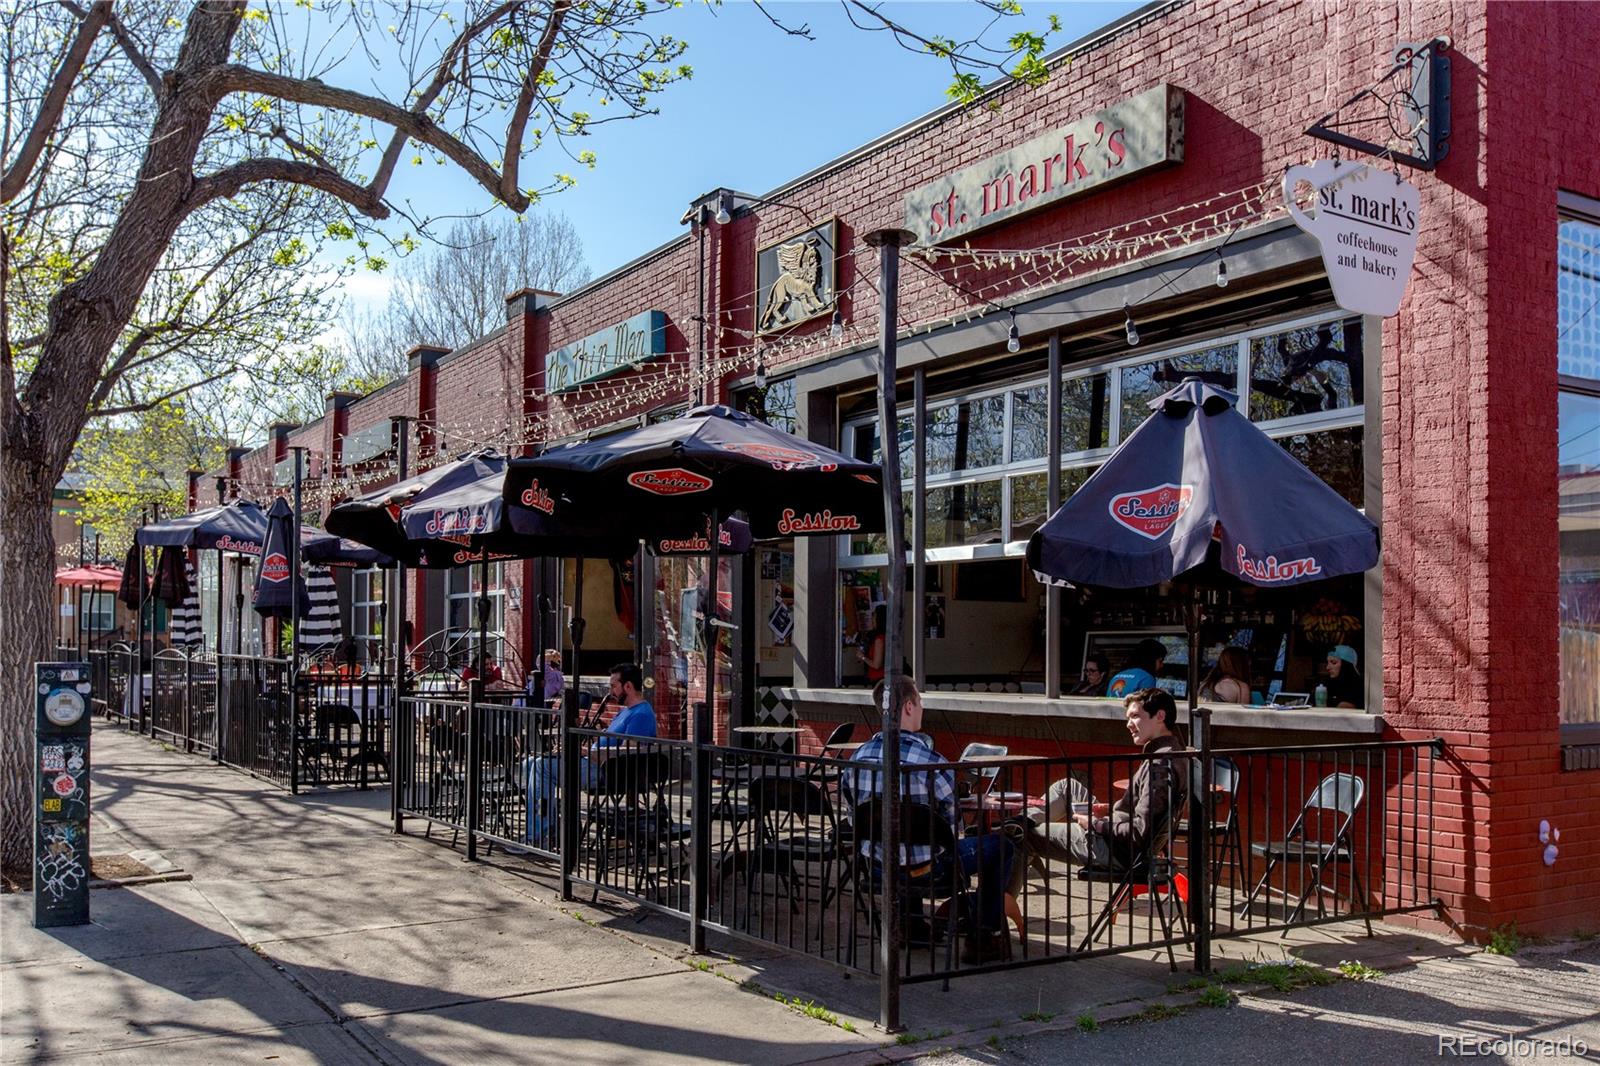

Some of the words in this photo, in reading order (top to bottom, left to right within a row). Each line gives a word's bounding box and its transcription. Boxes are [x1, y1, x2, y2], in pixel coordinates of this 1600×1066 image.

[930, 186, 968, 235] st.
[980, 120, 1127, 216] mark's
[1319, 186, 1343, 210] st.
[1351, 193, 1416, 231] mark's
[1336, 231, 1399, 258] coffeehouse
[1337, 254, 1357, 269] and
[1362, 256, 1397, 280] bakery
[547, 351, 568, 391] the
[572, 339, 608, 382] thin
[614, 322, 645, 366] Man
[779, 508, 861, 535] Session
[1236, 542, 1322, 582] Session
